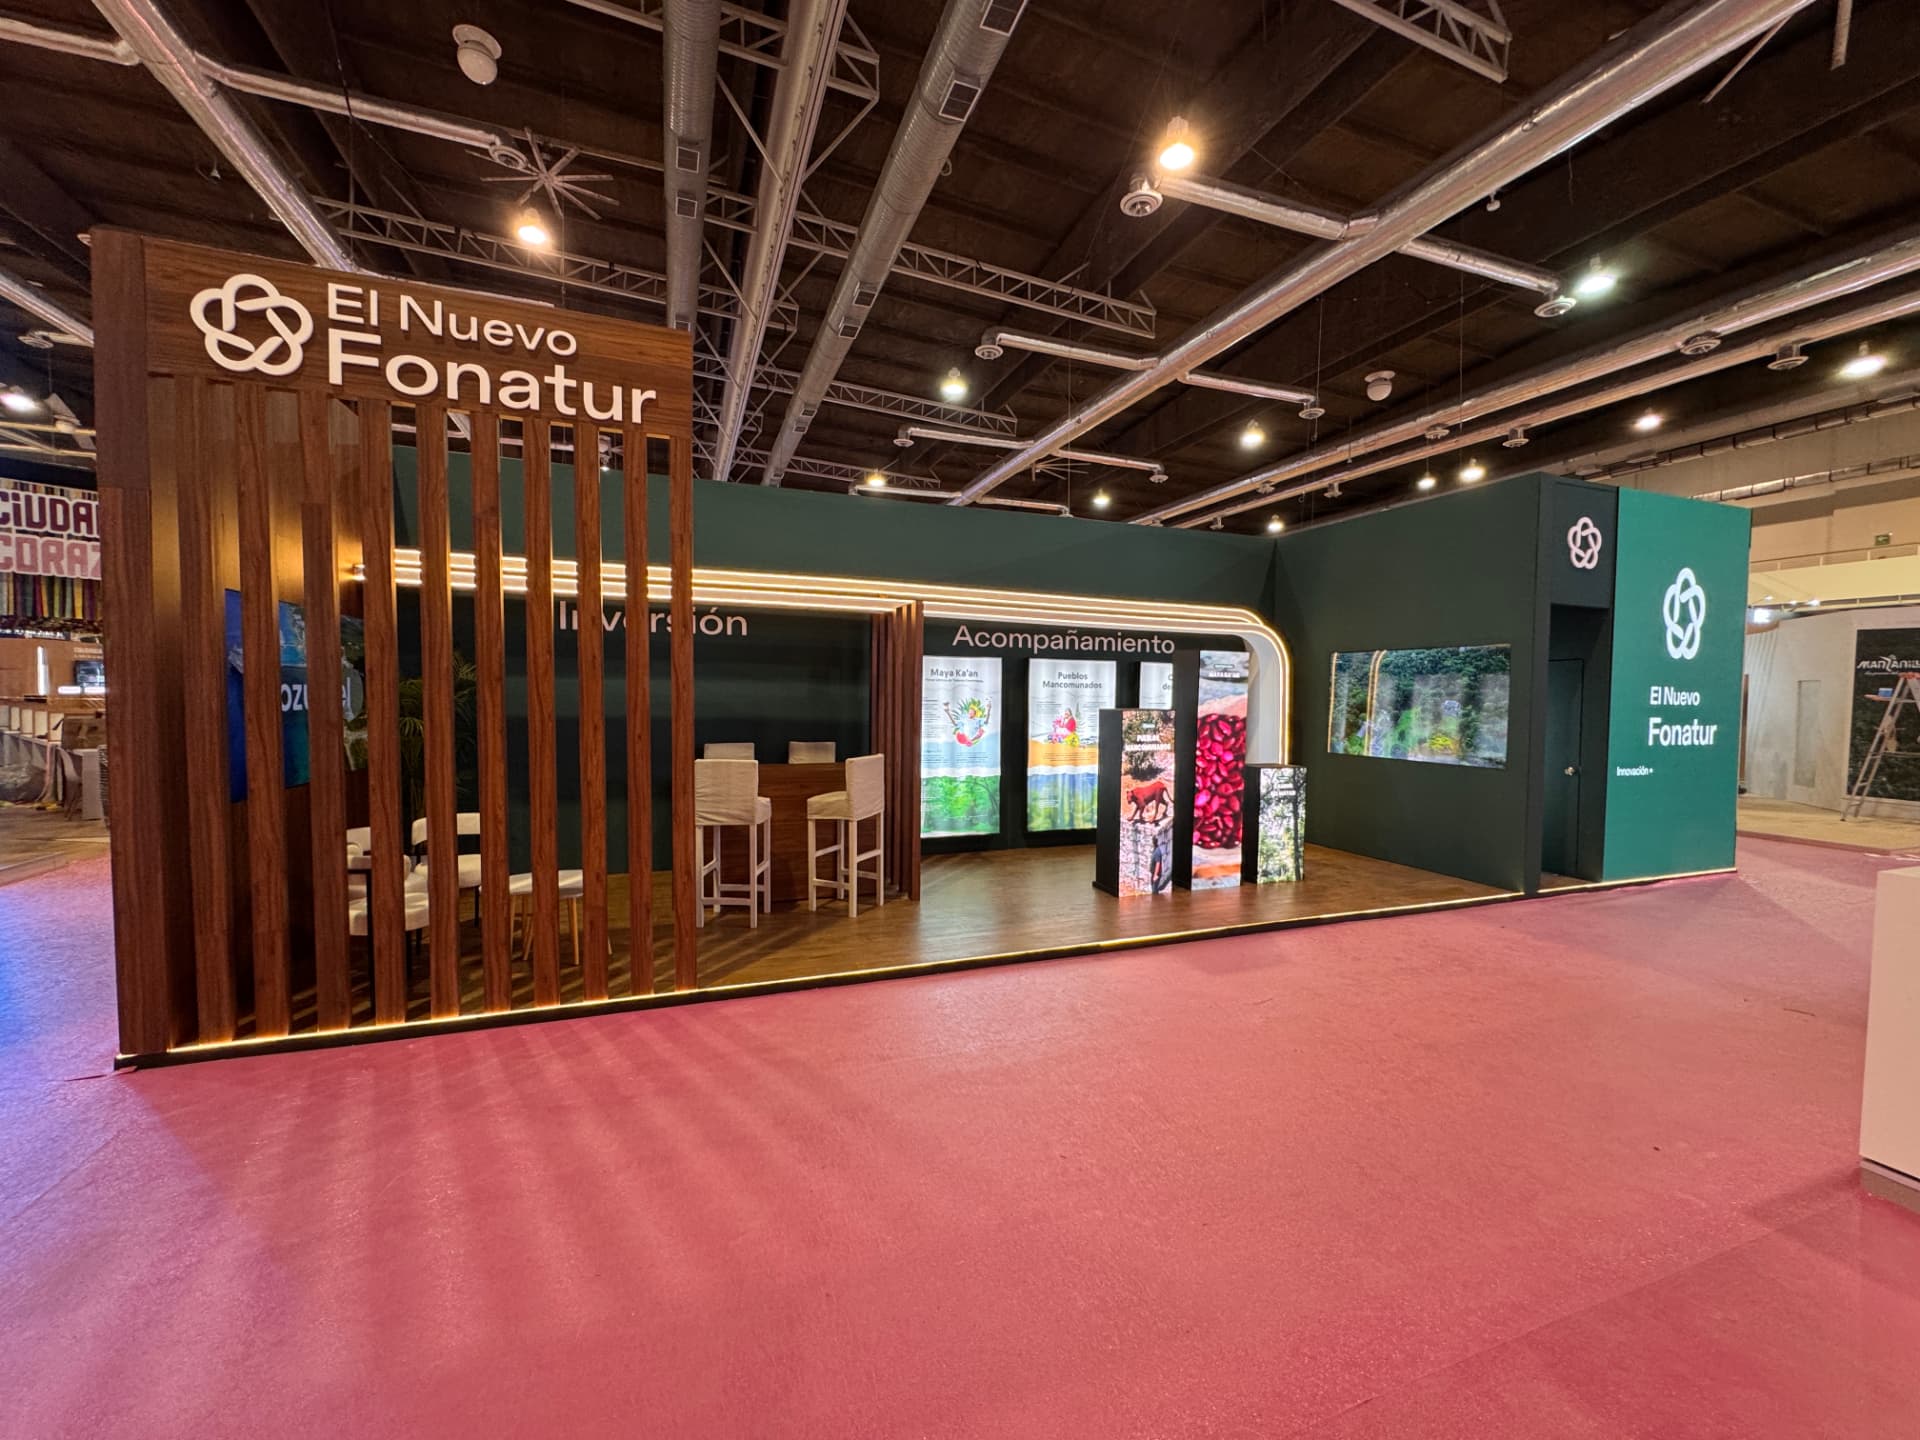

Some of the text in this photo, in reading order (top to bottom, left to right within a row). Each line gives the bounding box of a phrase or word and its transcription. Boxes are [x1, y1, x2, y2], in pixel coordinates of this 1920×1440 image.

[326, 282, 578, 357] El Nuevo
[327, 328, 657, 424] Fonatur
[951, 624, 1175, 654] Acompañamiento
[1042, 680, 1103, 689] Mancomunados
[1057, 671, 1089, 681] Pueblos
[1649, 685, 1701, 706] El Nuevo
[1647, 717, 1718, 746] Fonatur
[1616, 765, 1649, 776] Innovación
